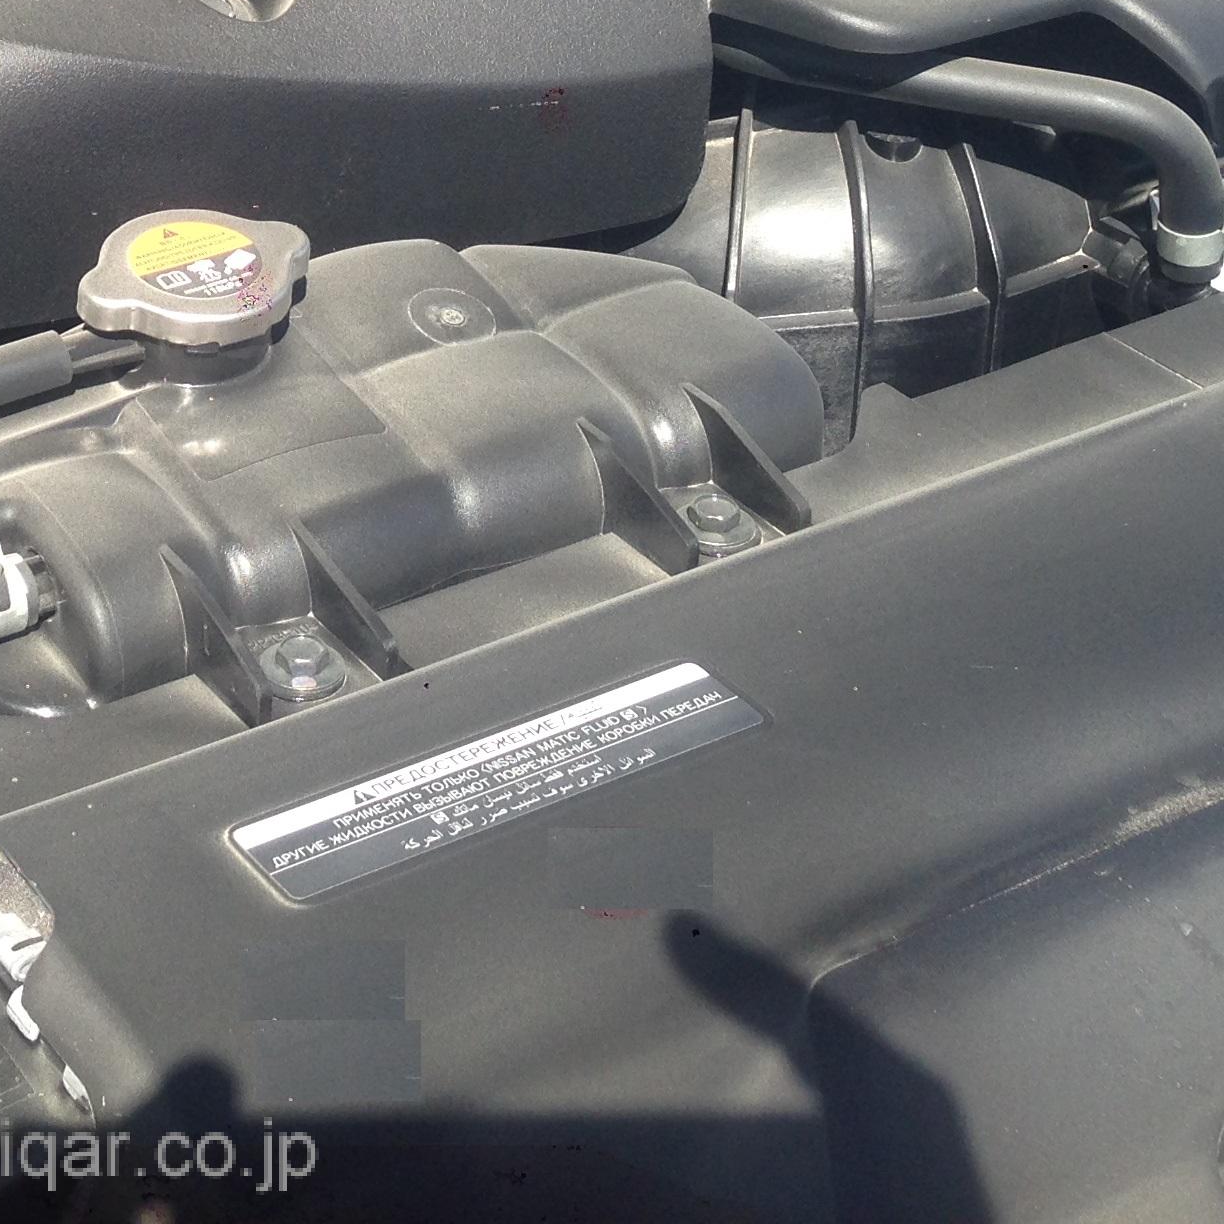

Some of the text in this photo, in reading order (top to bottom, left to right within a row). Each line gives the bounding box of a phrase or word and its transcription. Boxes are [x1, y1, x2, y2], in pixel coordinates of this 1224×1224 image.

[272, 690, 723, 869] ДРУГИЕ ЖИДКОСТИ ВЫЗЫВАЮТ ПОВРЕЖДЕНИЕ КОРОБКИ ПЕРЕДАЧ
[332, 790, 422, 829] ПРИМЕНЯТЬ
[421, 768, 480, 795] ТОЛЬКО
[537, 730, 581, 752] MATIC
[581, 714, 621, 737] FLUID
[372, 718, 556, 794] ПРЕДОСТЕРЕЖЕНИЕ
